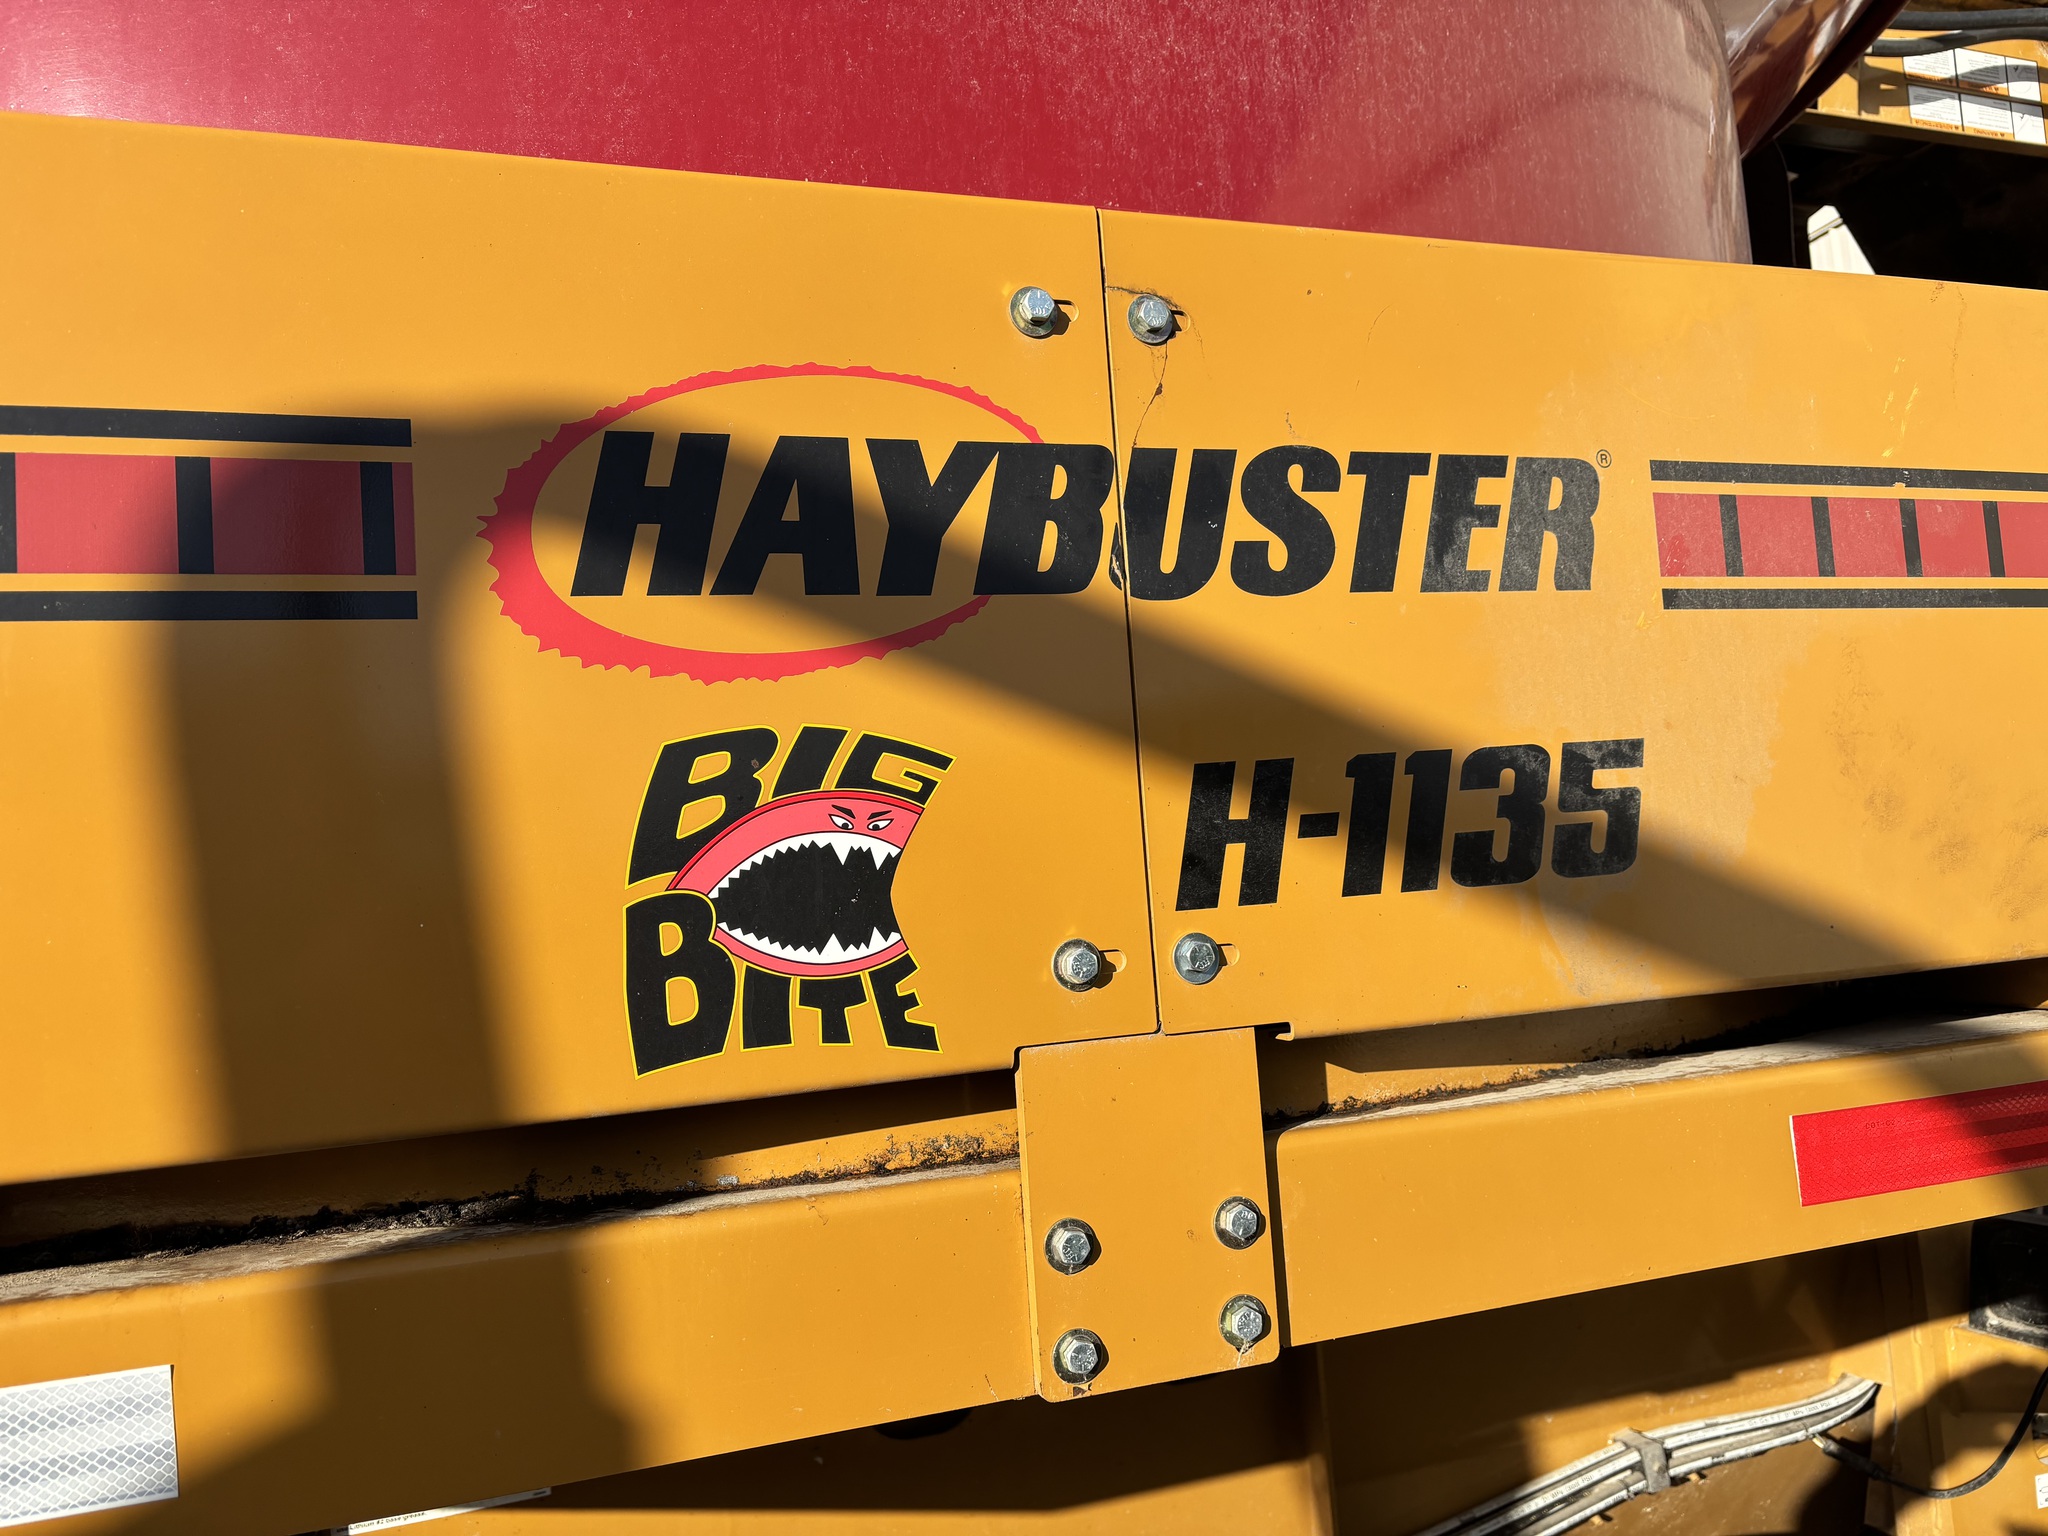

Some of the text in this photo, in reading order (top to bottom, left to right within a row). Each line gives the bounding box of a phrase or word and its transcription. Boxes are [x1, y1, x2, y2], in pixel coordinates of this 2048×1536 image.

[569, 429, 1601, 601] HAYBUSTER
[625, 723, 957, 890] BIG
[1175, 737, 1645, 912] H-1135
[622, 890, 943, 1080] BITE
